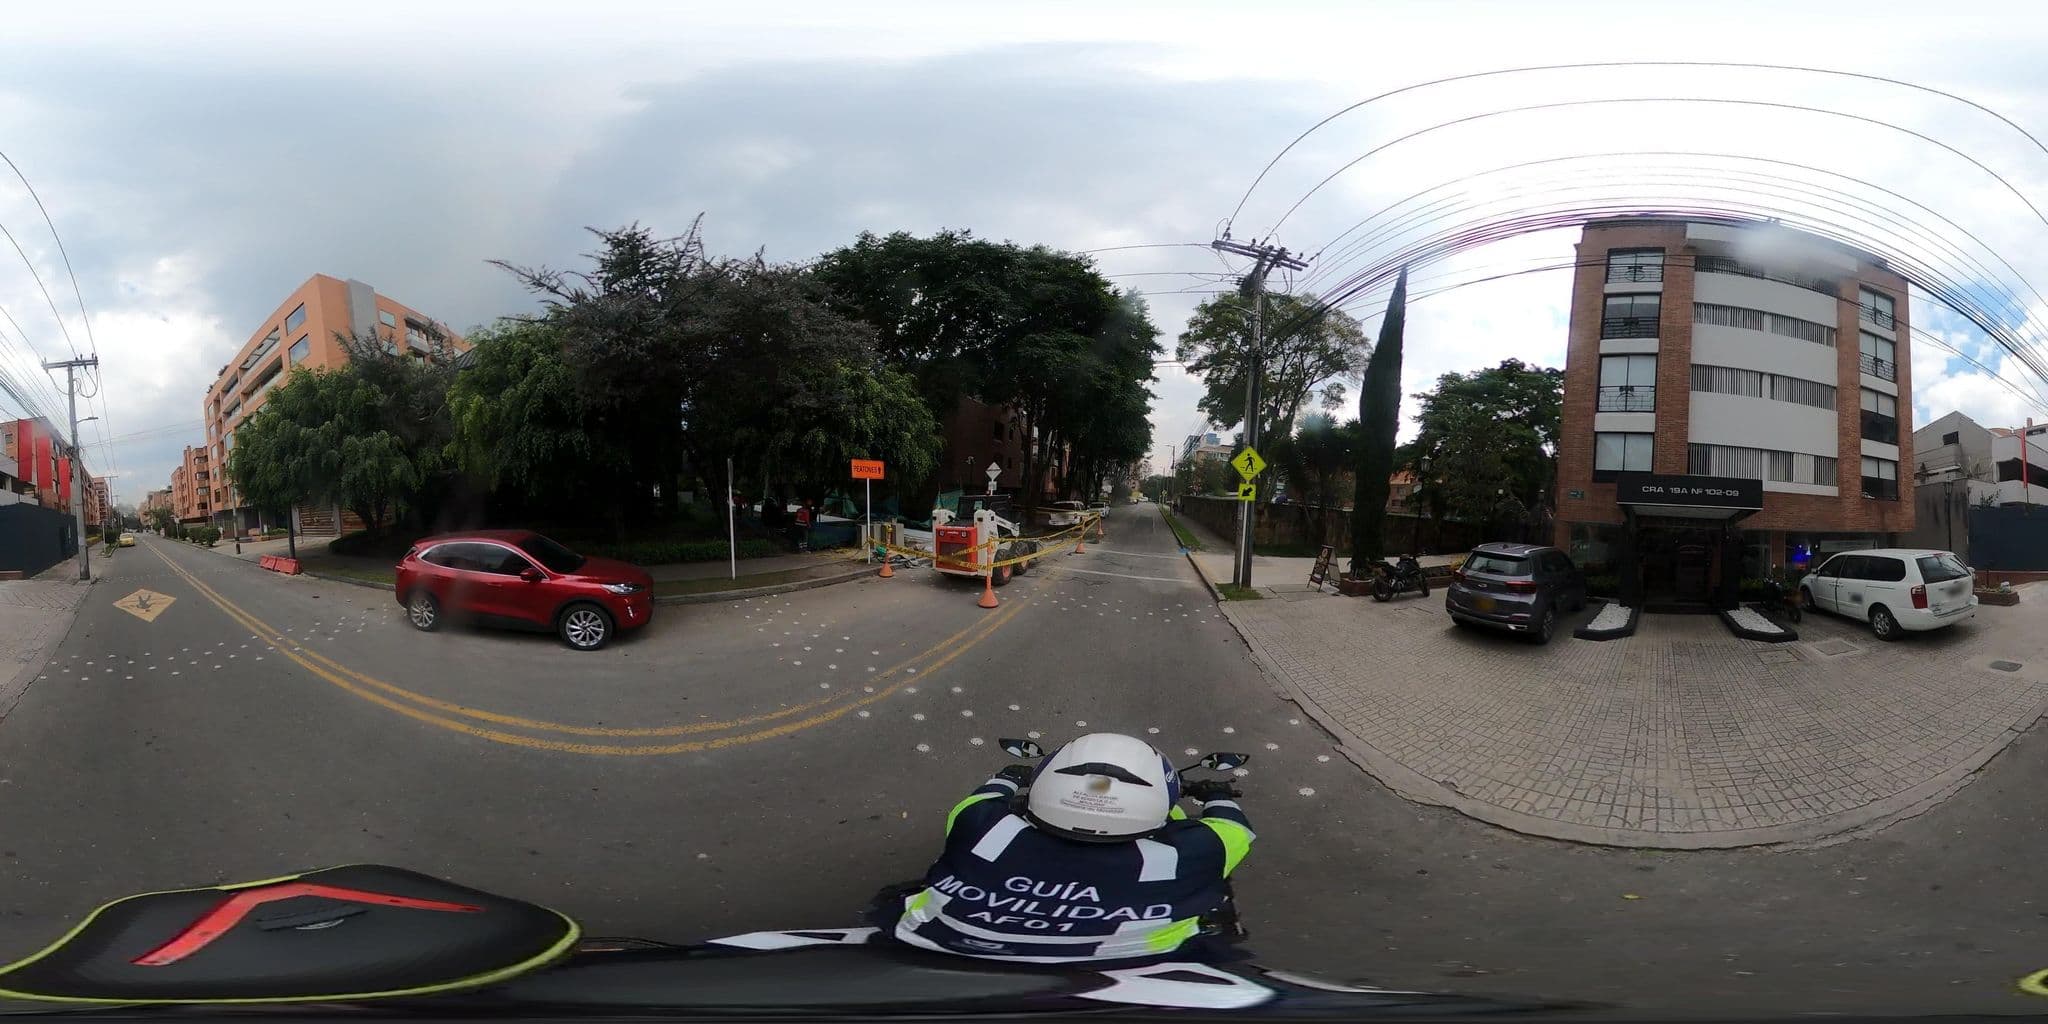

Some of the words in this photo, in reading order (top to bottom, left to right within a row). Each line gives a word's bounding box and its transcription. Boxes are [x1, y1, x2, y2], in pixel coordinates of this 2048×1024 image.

[934, 874, 1173, 920] MOVILIDAD
[1004, 875, 1101, 902] GUÍA
[967, 911, 1074, 932] AF01
